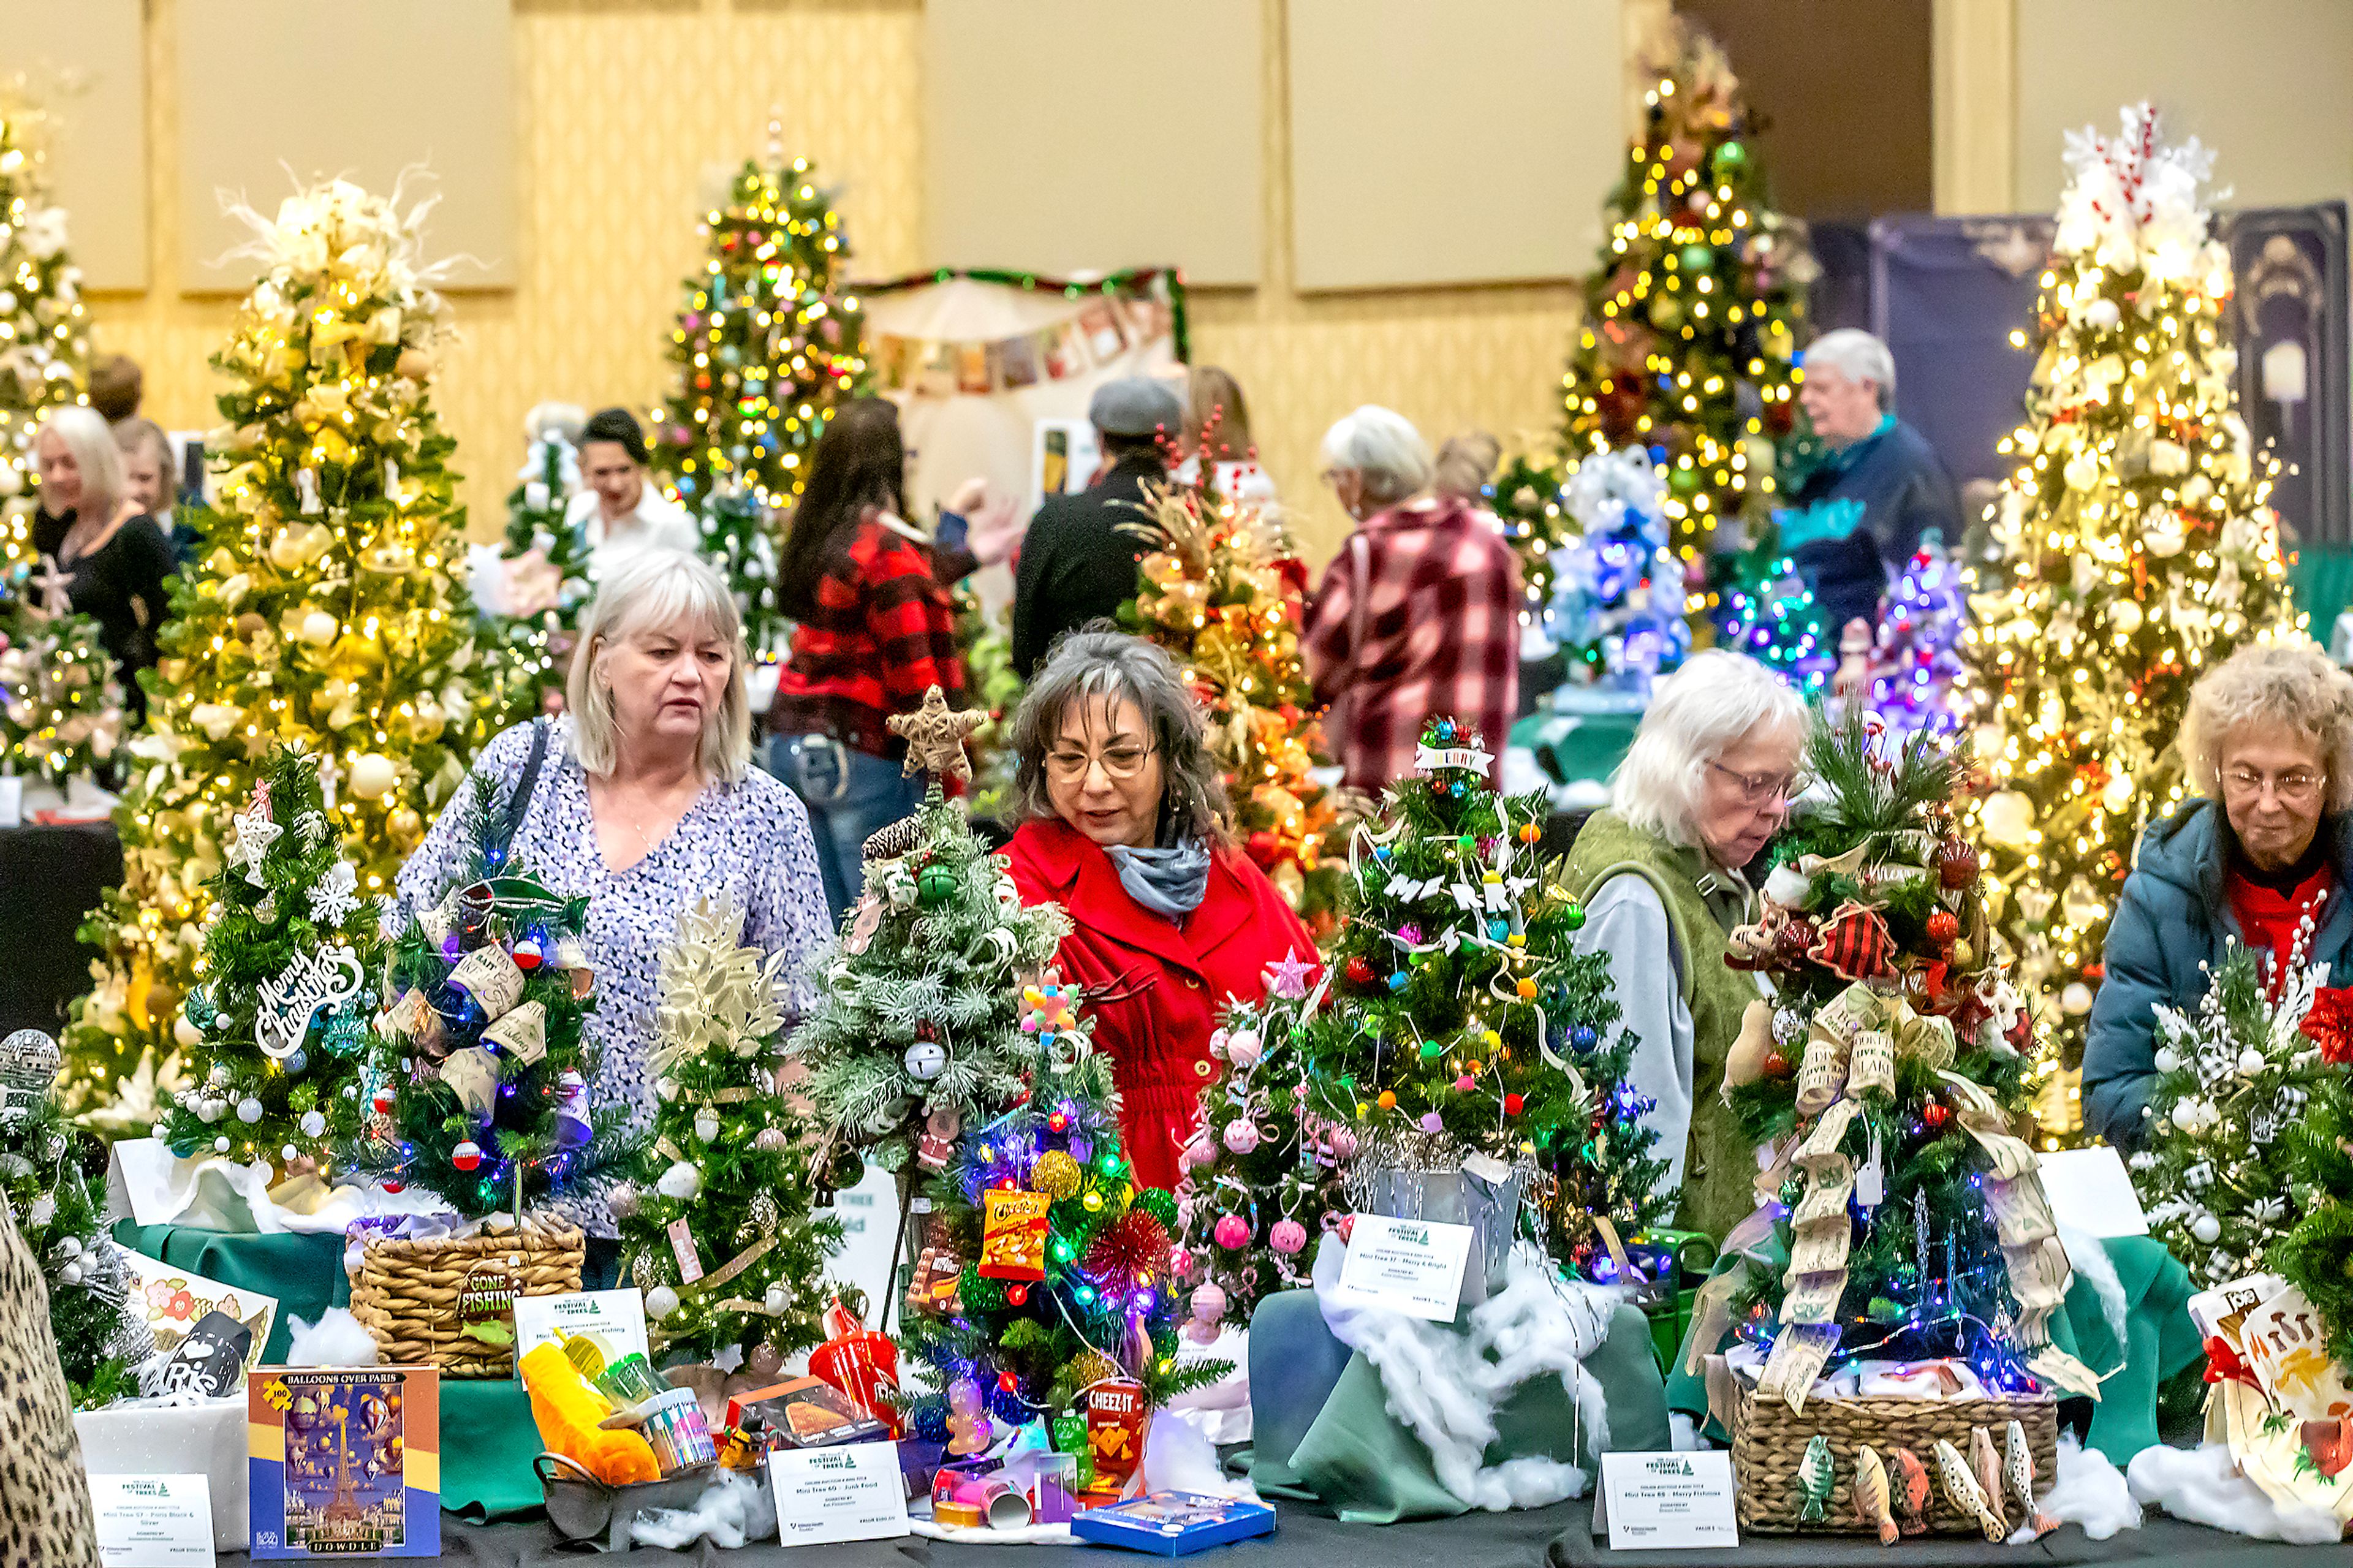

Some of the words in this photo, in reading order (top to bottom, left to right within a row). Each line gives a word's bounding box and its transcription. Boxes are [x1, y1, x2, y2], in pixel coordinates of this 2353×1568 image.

[1434, 752, 1476, 767] MERRY
[256, 948, 317, 1010] Merry
[255, 944, 364, 1059] Christmas
[1389, 1227, 1419, 1236] FESTIVAL
[471, 1274, 506, 1291] GONE
[462, 1289, 520, 1315] FISHING
[288, 1375, 339, 1385] BALLOONS
[340, 1374, 367, 1384] OVER
[369, 1374, 396, 1383] PARIS
